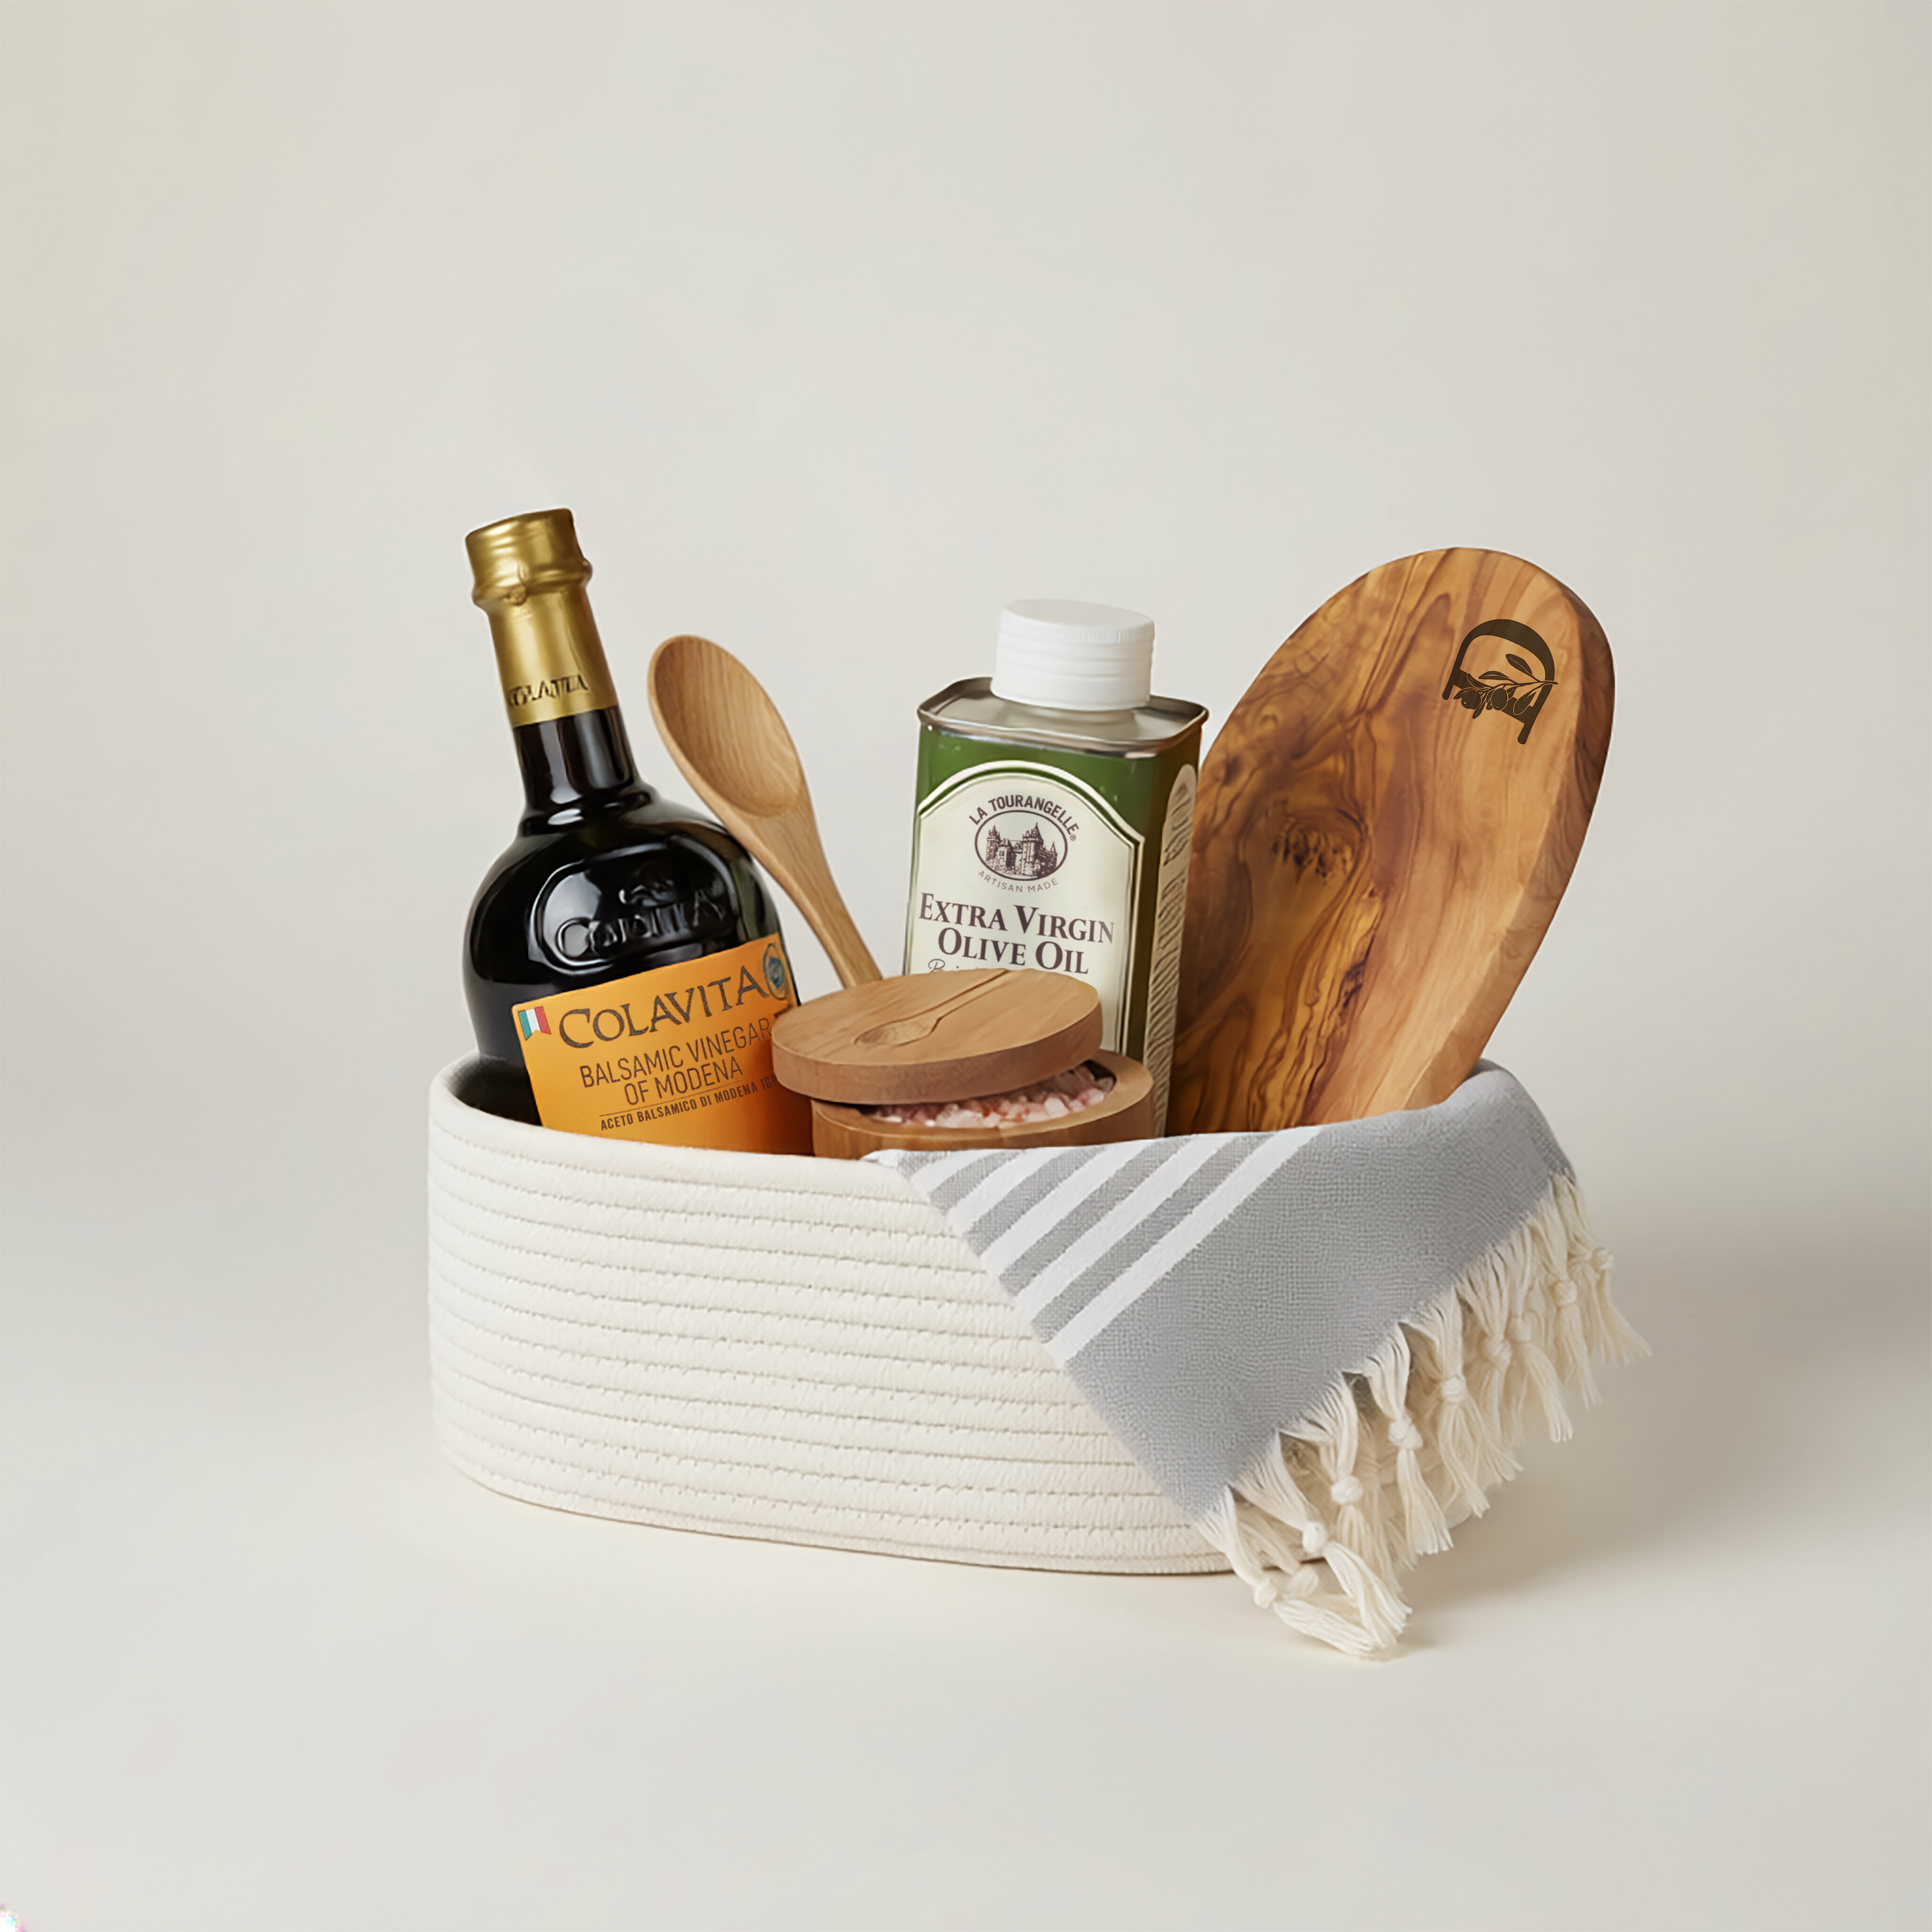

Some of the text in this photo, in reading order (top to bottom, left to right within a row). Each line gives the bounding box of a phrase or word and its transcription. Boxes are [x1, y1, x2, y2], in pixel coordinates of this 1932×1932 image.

[968, 806, 988, 825] LA
[978, 870, 1059, 893] ARTISAN MADE
[918, 892, 1115, 944] EXTRA VIRGIN
[937, 927, 1089, 974] OLIVE OIL
[559, 965, 770, 1049] COLAVITA
[580, 1017, 772, 1088] BALSAMIC VINEGAR
[600, 1112, 634, 1131] ACETO
[637, 1099, 697, 1123] BALSAMICO
[701, 1093, 712, 1108] DI
[714, 1081, 759, 1103] MODENA
[624, 1056, 744, 1106] OF MODENA
